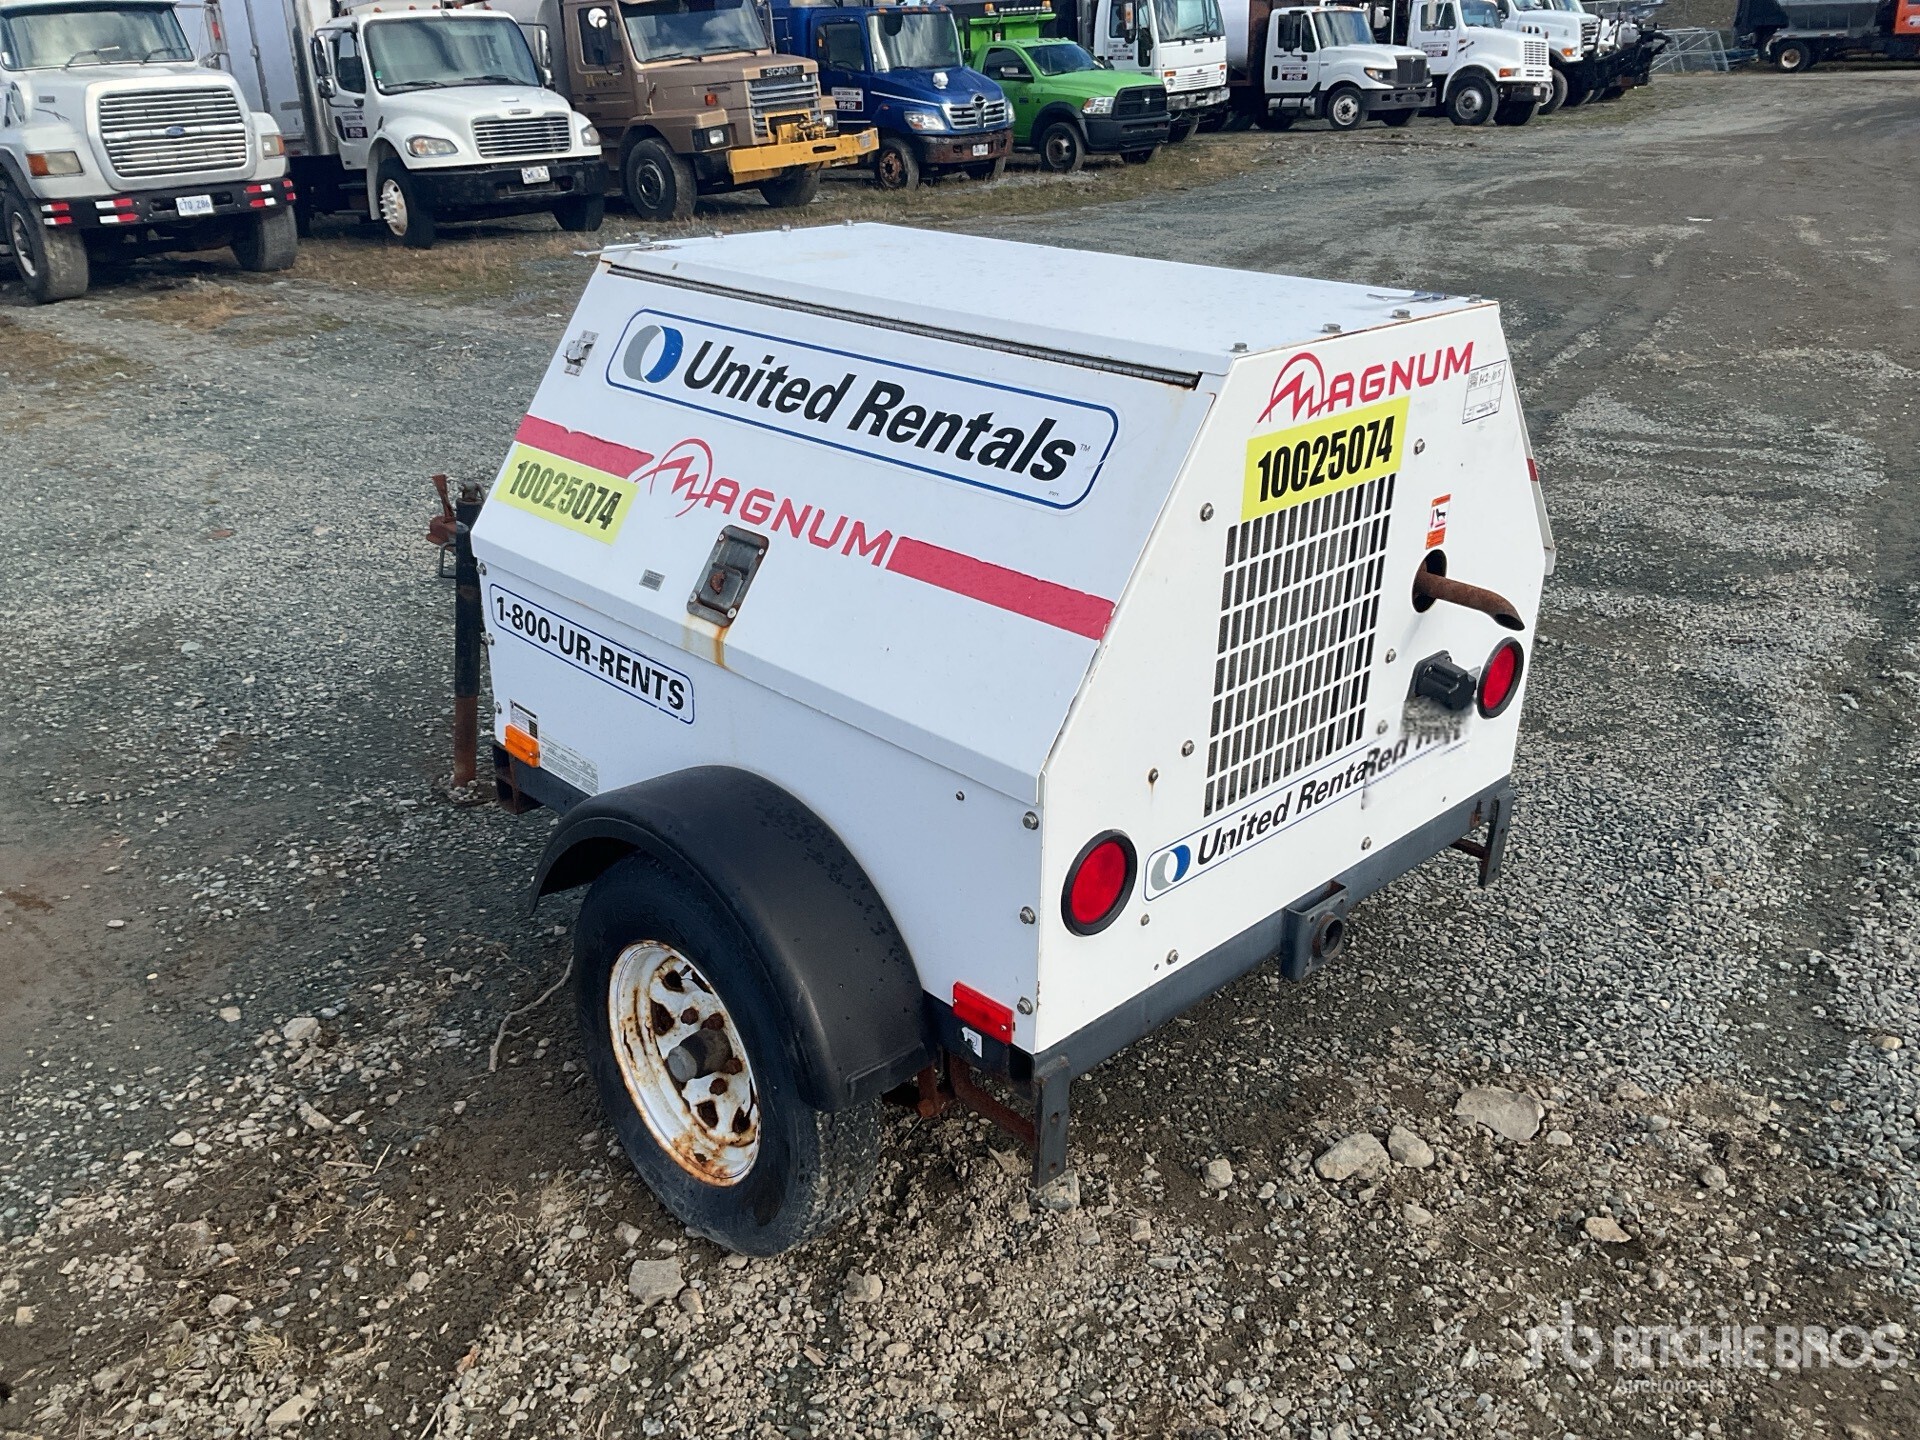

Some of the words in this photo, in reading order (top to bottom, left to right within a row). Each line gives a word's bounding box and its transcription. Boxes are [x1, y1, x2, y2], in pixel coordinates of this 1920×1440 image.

[766, 66, 799, 77] SCANIA
[684, 340, 857, 424] United
[846, 380, 1077, 481] Rentals
[1256, 340, 1475, 424] MAGNUM
[508, 460, 623, 531] 10025074
[1257, 414, 1396, 503] 10025074
[634, 437, 894, 568] MAGNUM
[496, 596, 685, 711] 1-800-UR-RENTS
[1198, 790, 1292, 865] United
